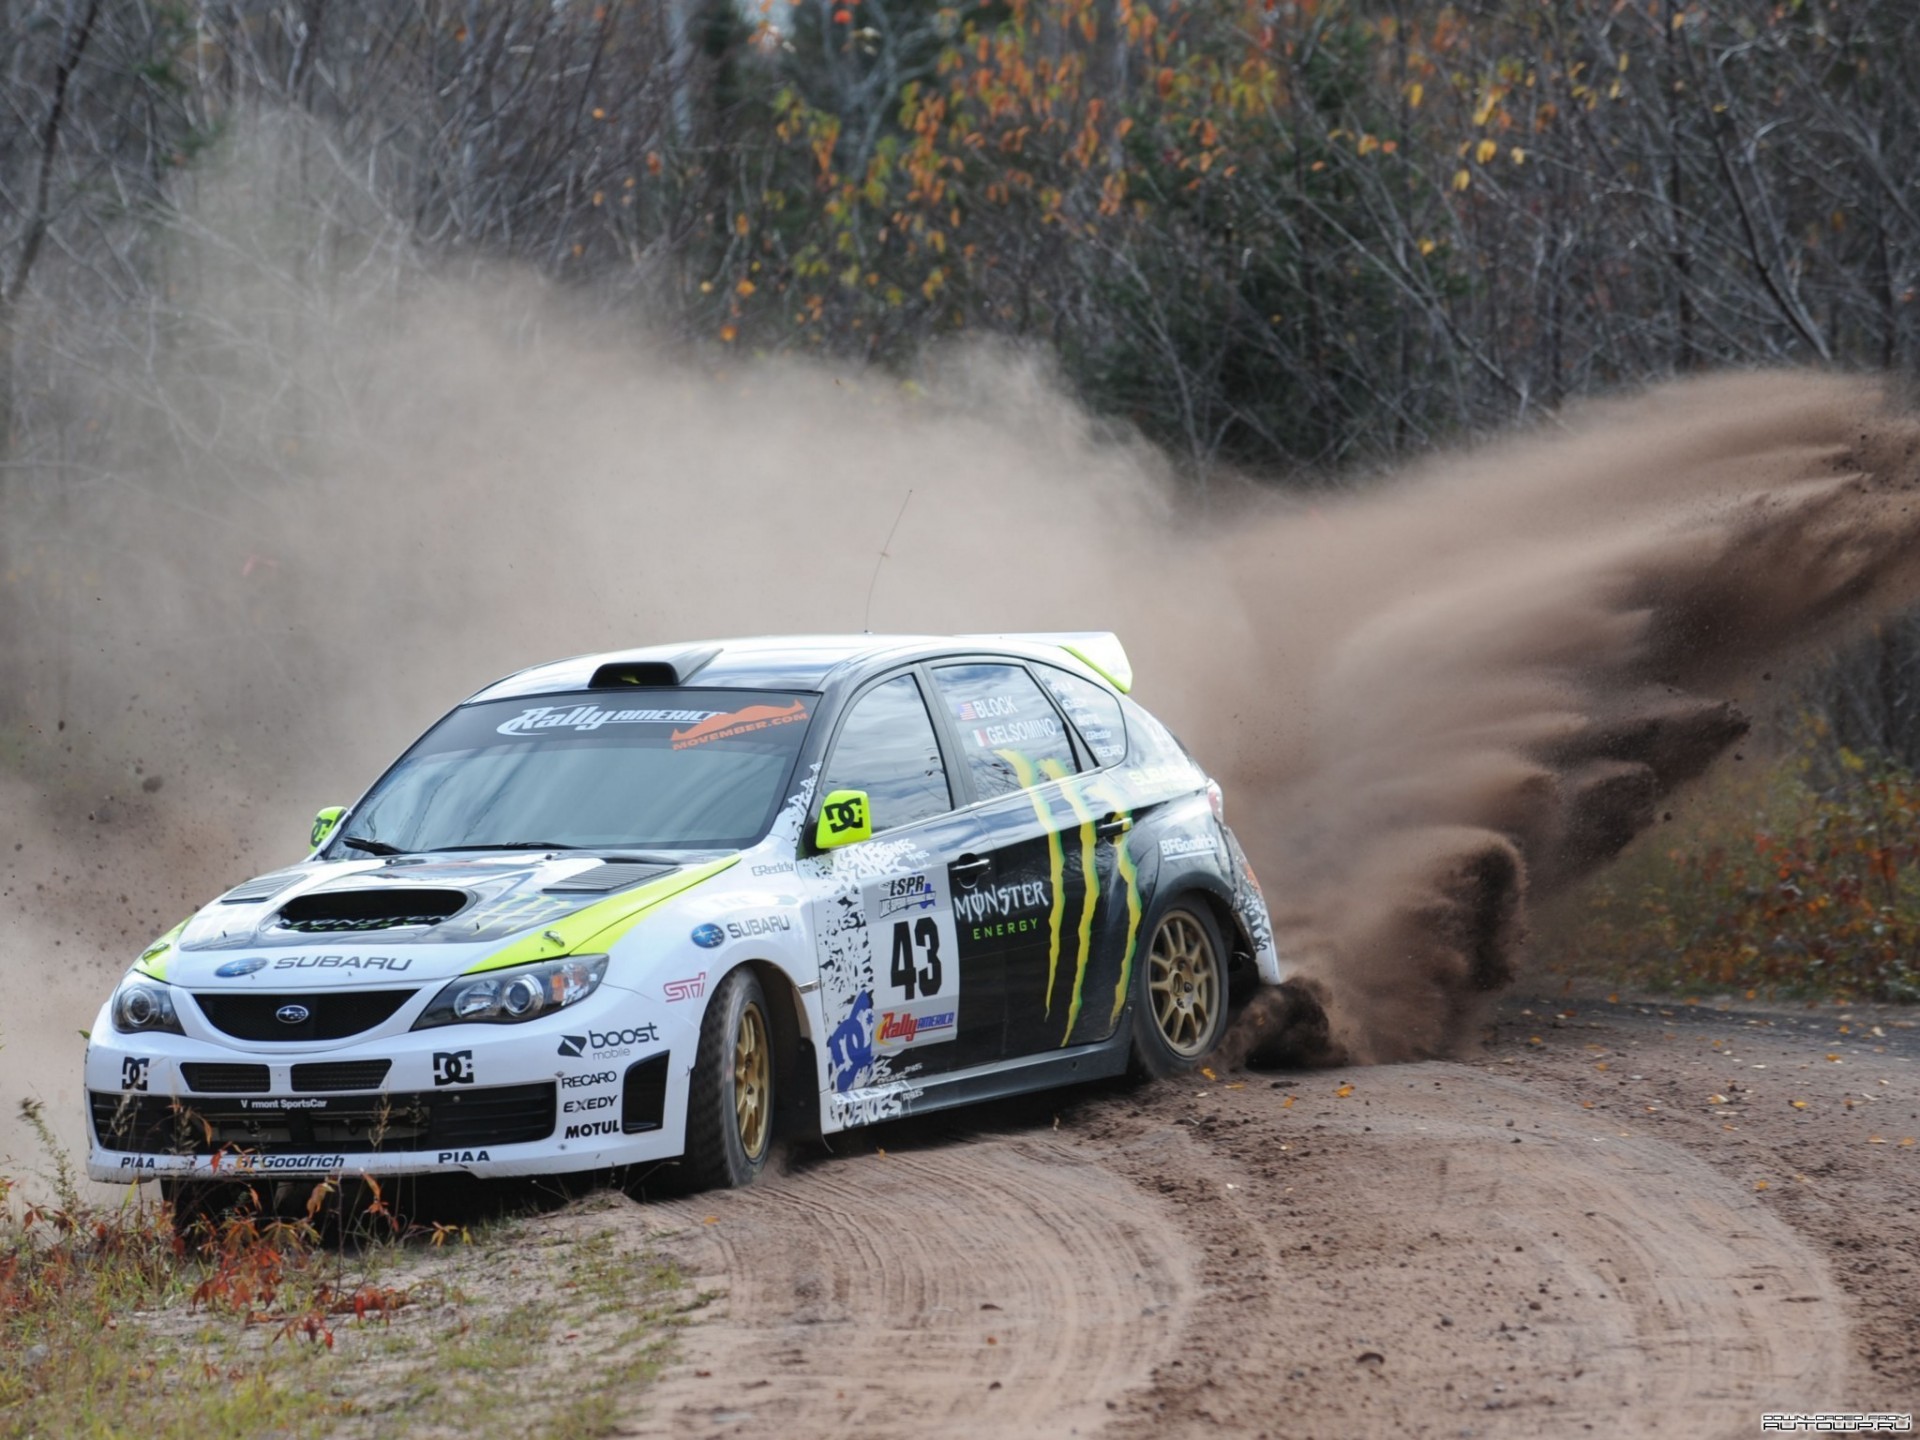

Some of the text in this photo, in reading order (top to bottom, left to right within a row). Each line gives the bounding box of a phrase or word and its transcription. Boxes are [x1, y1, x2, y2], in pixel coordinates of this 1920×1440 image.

[610, 709, 728, 722] AMERIC
[972, 696, 1019, 719] BLOCK
[671, 711, 808, 751] MOVEMBER.COM
[986, 717, 1057, 745] GELSOMINO
[953, 881, 1050, 923] MONSTER
[727, 914, 791, 939] SUBARU
[973, 918, 1039, 941] ENERGY
[273, 955, 413, 972] SUBARU
[890, 916, 943, 1001] 43
[588, 1022, 660, 1049] boost
[876, 1010, 918, 1043] Rally
[593, 1046, 631, 1061] mobile
[561, 1071, 617, 1089] RECARO
[280, 1099, 328, 1111] SportsCar
[563, 1095, 618, 1113] EXEDY
[564, 1120, 620, 1139] MOTUL
[120, 1156, 155, 1169] PIAA
[438, 1150, 491, 1164] PIAA
